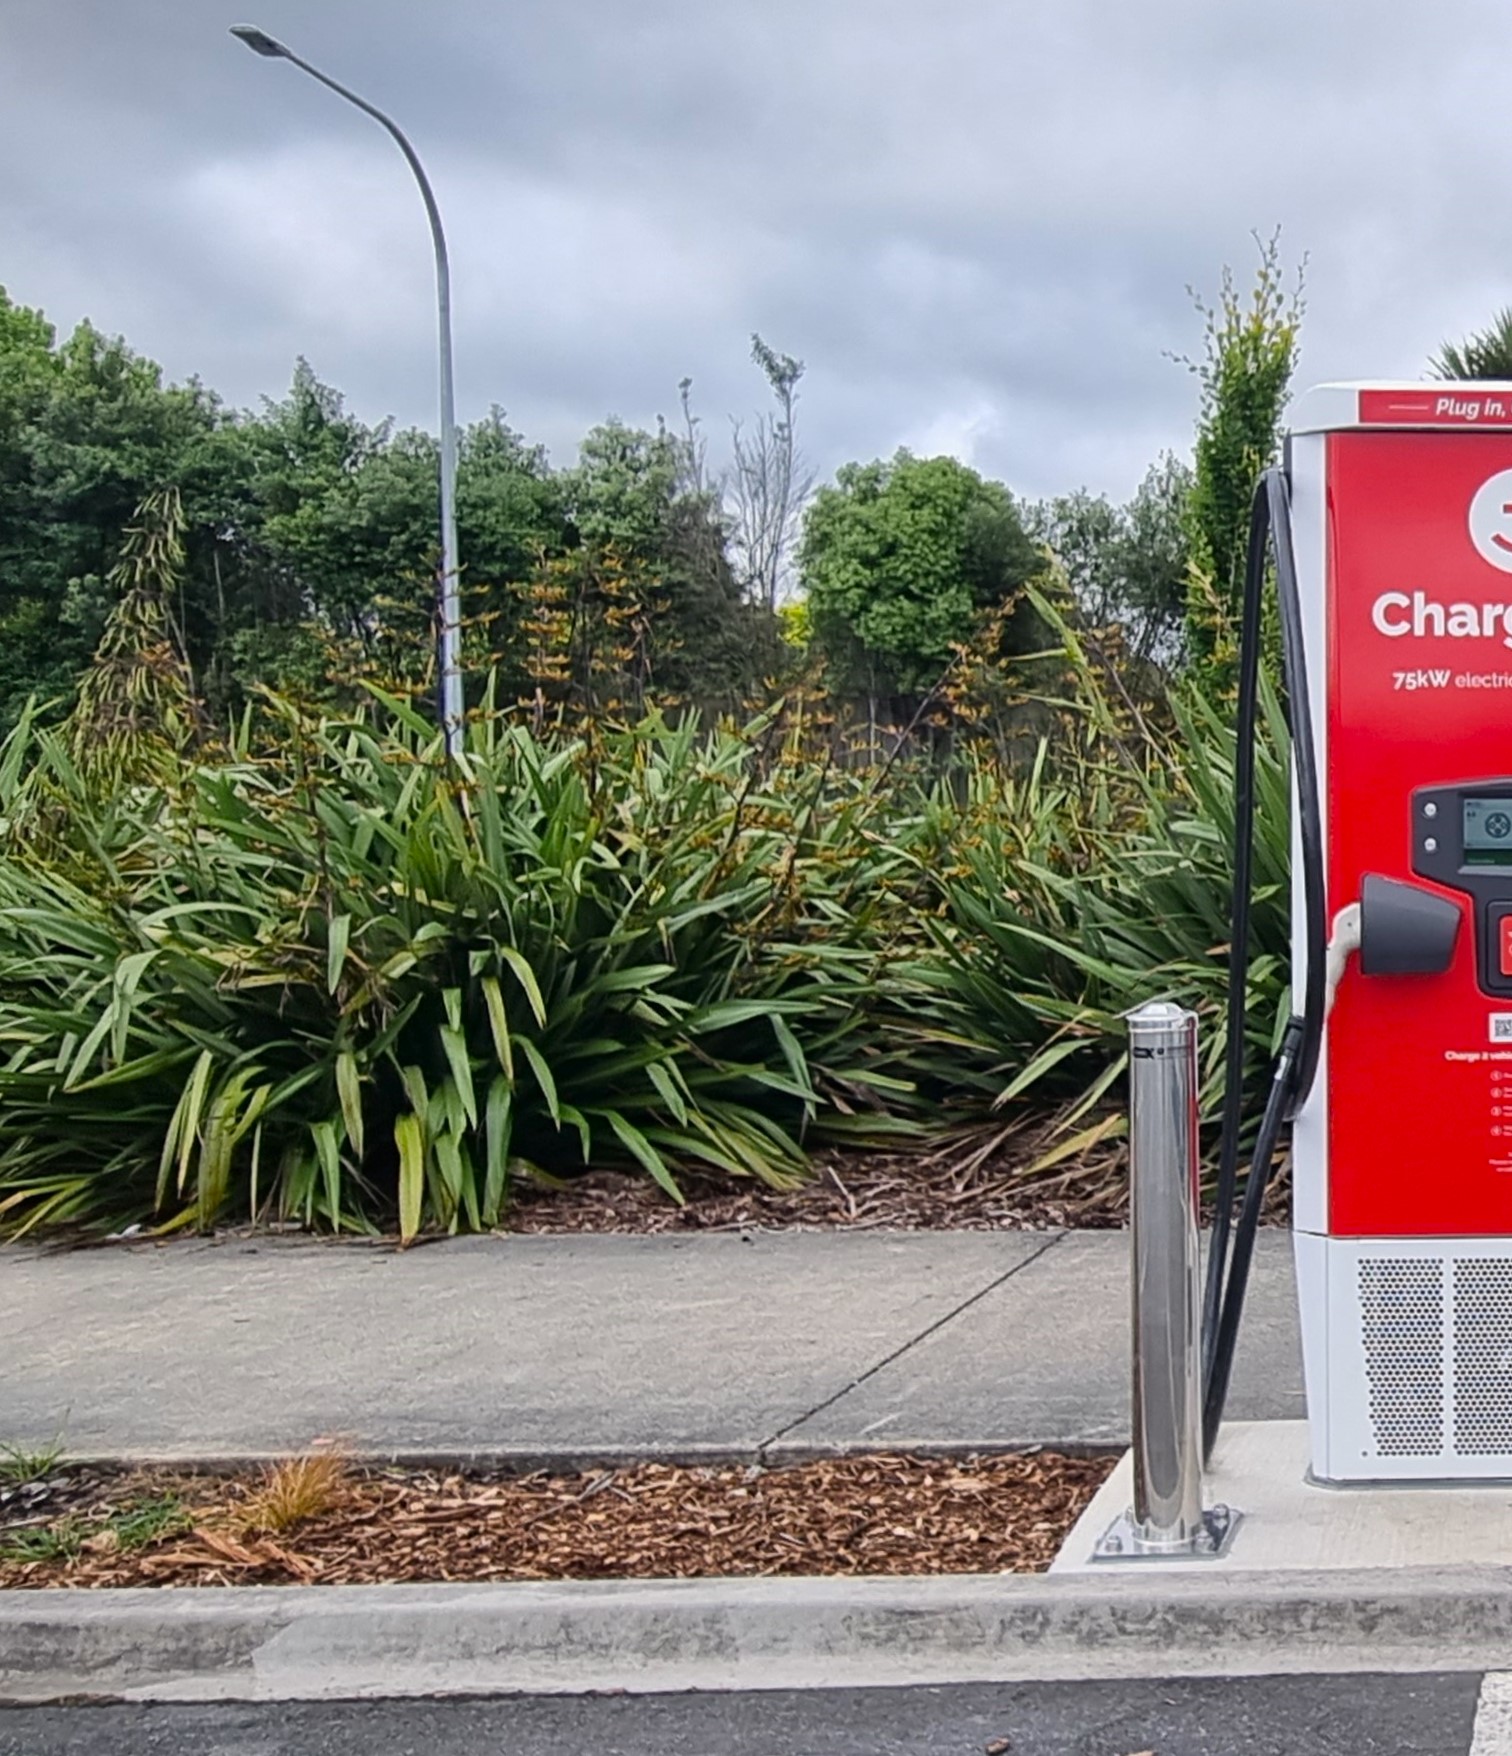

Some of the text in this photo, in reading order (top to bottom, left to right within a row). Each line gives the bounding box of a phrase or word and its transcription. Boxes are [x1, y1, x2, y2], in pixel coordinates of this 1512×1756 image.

[1436, 398, 1479, 420] Plug
[1484, 398, 1506, 417] in,
[1393, 670, 1451, 690] 75kW
[1445, 1050, 1480, 1063] Charge
